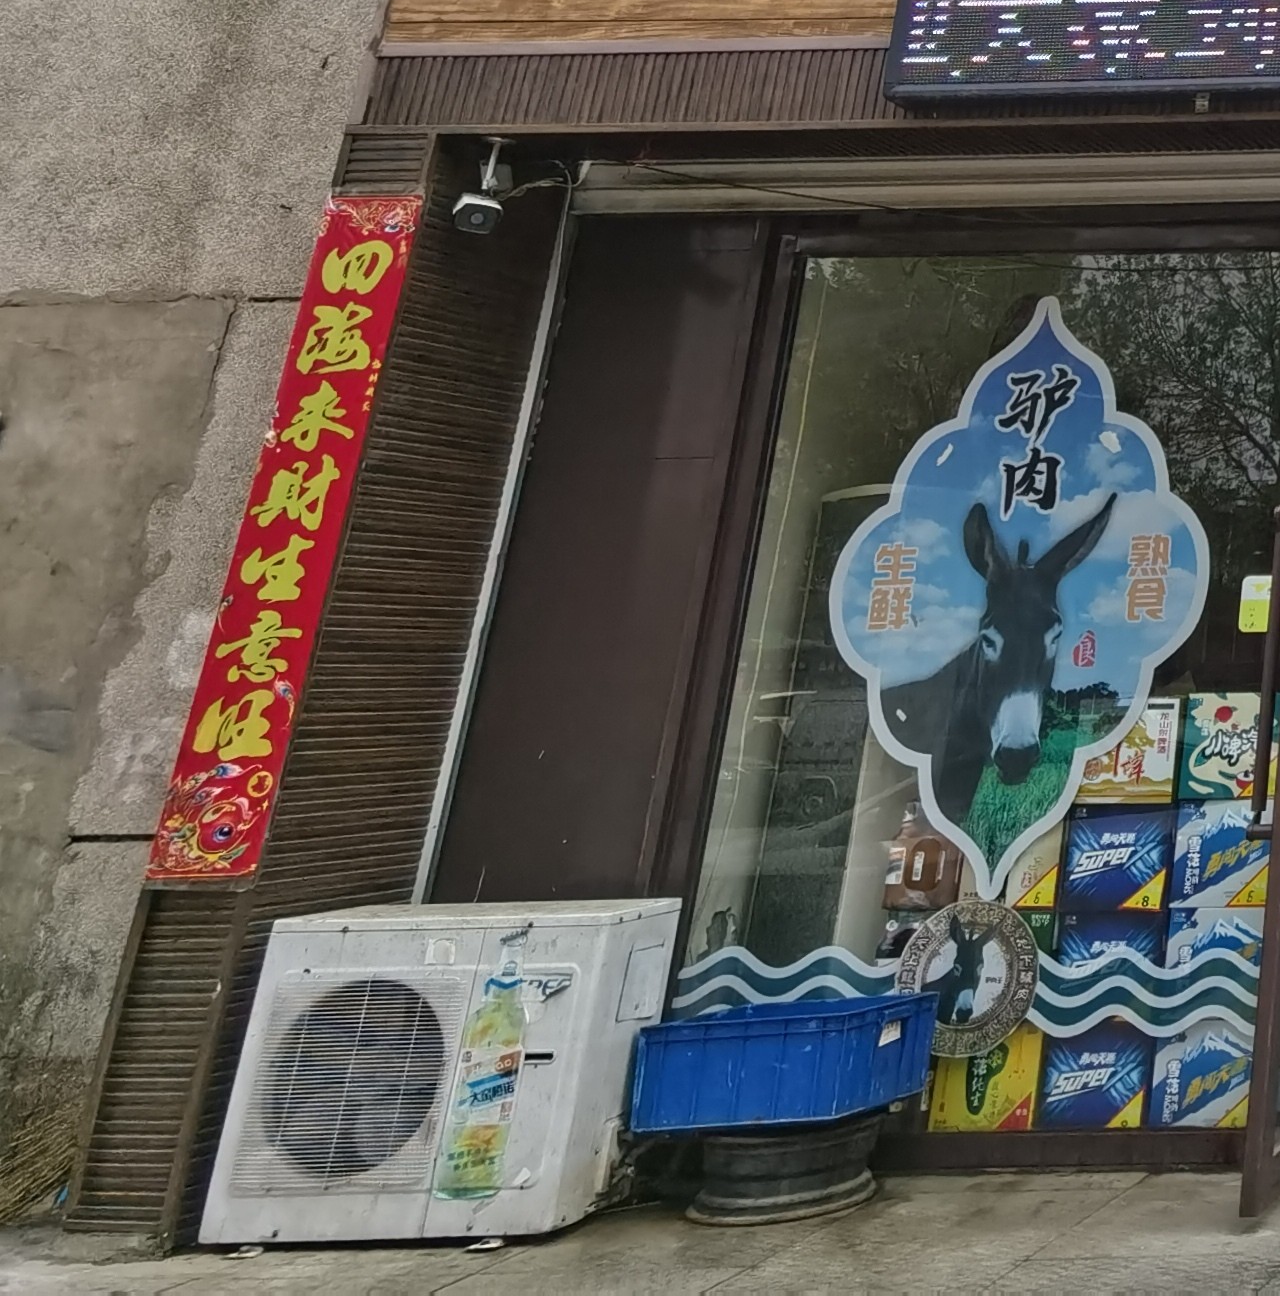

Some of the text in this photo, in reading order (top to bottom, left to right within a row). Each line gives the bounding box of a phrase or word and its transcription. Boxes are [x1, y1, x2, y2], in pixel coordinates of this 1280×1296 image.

[997, 368, 1080, 518] 驴肉
[867, 541, 919, 632] 生鲜
[1125, 533, 1171, 622] 熟食
